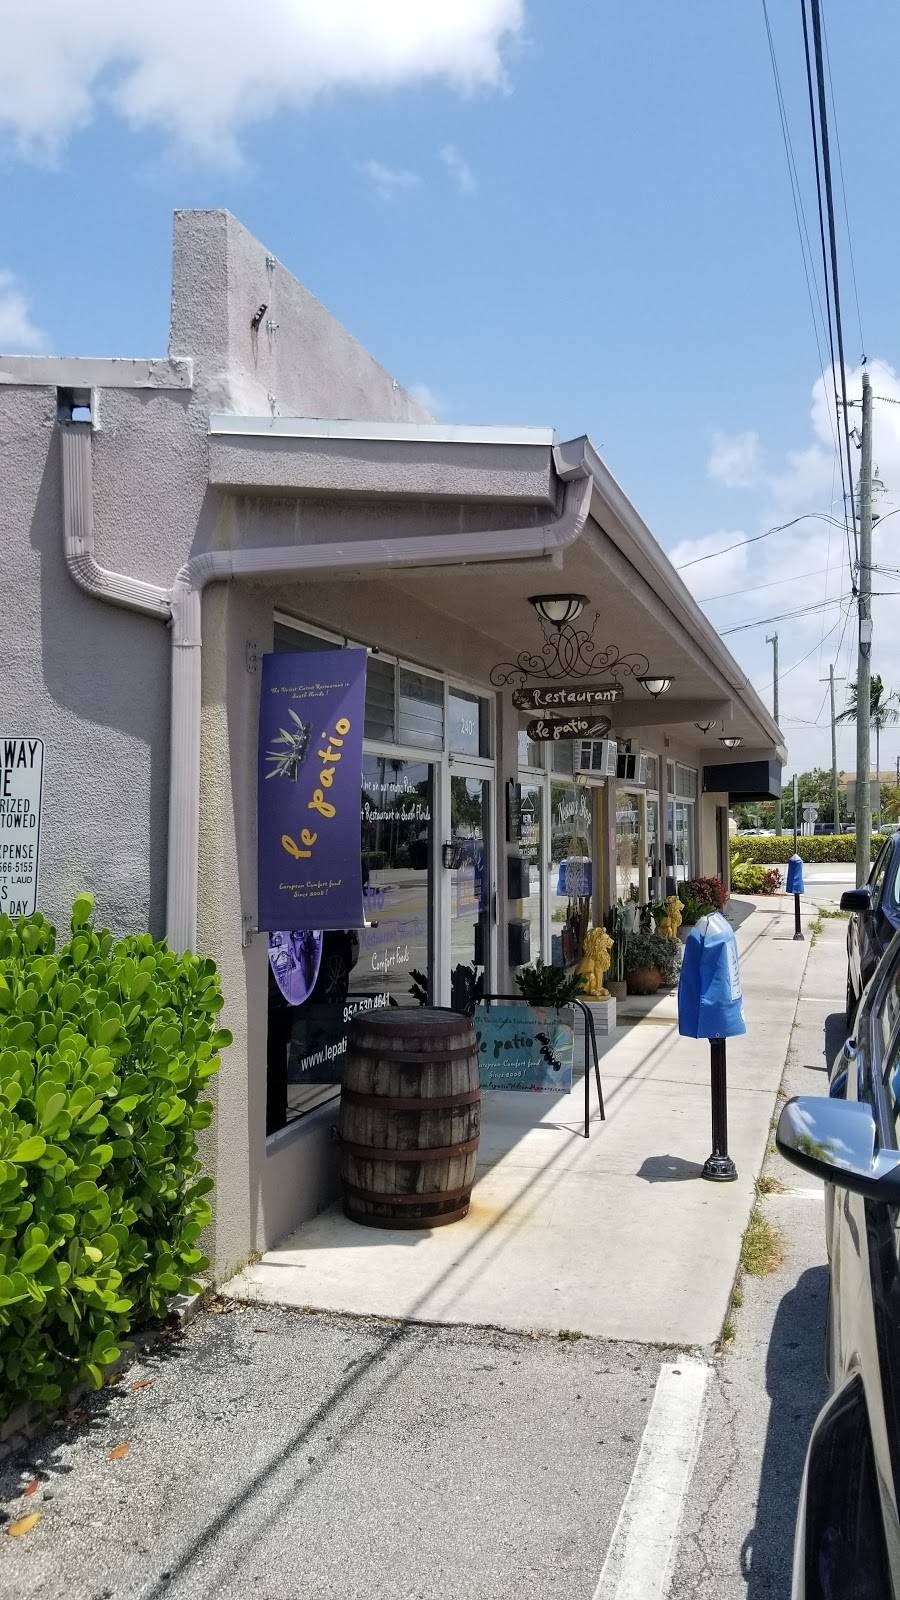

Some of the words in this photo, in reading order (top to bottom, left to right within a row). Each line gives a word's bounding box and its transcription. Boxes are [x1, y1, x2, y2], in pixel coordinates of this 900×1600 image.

[532, 689, 619, 706] Restaurant
[536, 720, 550, 738] le
[553, 716, 589, 740] patio
[281, 828, 318, 859] le
[307, 717, 352, 818] patio
[1, 813, 36, 828] TOWED
[364, 801, 395, 823] Restaurant
[0, 844, 34, 859] PENSE
[11, 876, 33, 884] LAUD
[306, 881, 328, 889] Comfort
[10, 900, 29, 915] DAY
[371, 948, 396, 973] Comfort
[301, 1035, 349, 1072] www.lepati
[493, 1031, 534, 1059] patio
[503, 1058, 527, 1069] Comfort
